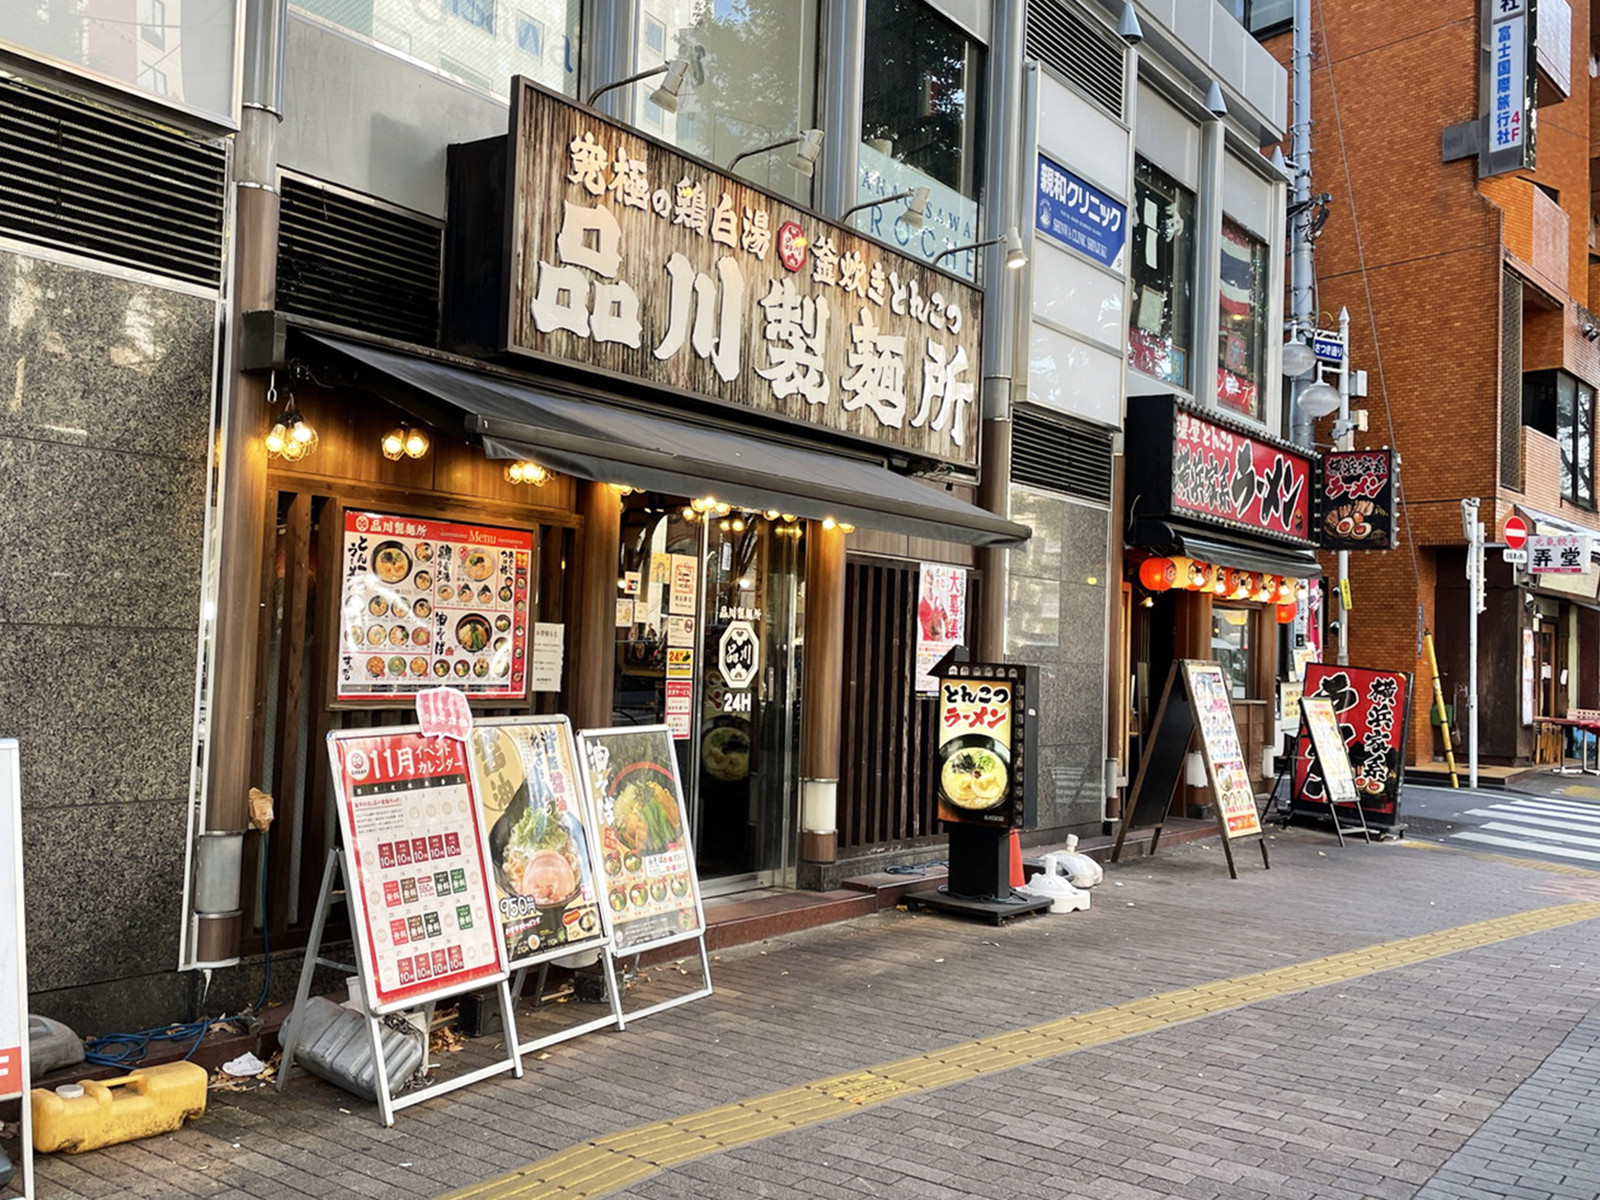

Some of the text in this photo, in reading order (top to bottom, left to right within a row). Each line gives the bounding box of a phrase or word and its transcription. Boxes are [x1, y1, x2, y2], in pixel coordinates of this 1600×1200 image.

[1496, 25, 1512, 145] 富士国際旅行社
[568, 132, 772, 260] 究極の鶏白湯
[1040, 162, 1122, 233] 親和クリニック
[531, 200, 975, 447] 品川製麺所
[1314, 343, 1343, 357] さつき通り
[1324, 475, 1388, 500] ラーメン
[370, 519, 428, 537] 品川製麺所
[469, 530, 497, 544] Menu
[1533, 547, 1581, 567] 弄堂
[724, 693, 752, 712] 24H
[944, 684, 1011, 705] とんこつ
[943, 706, 1009, 729] ラーメン
[1363, 677, 1399, 780] 横浜家系
[416, 743, 452, 758] イベント
[369, 747, 415, 780] 11月
[418, 758, 463, 774] カレンダー
[586, 739, 615, 826] 油そば
